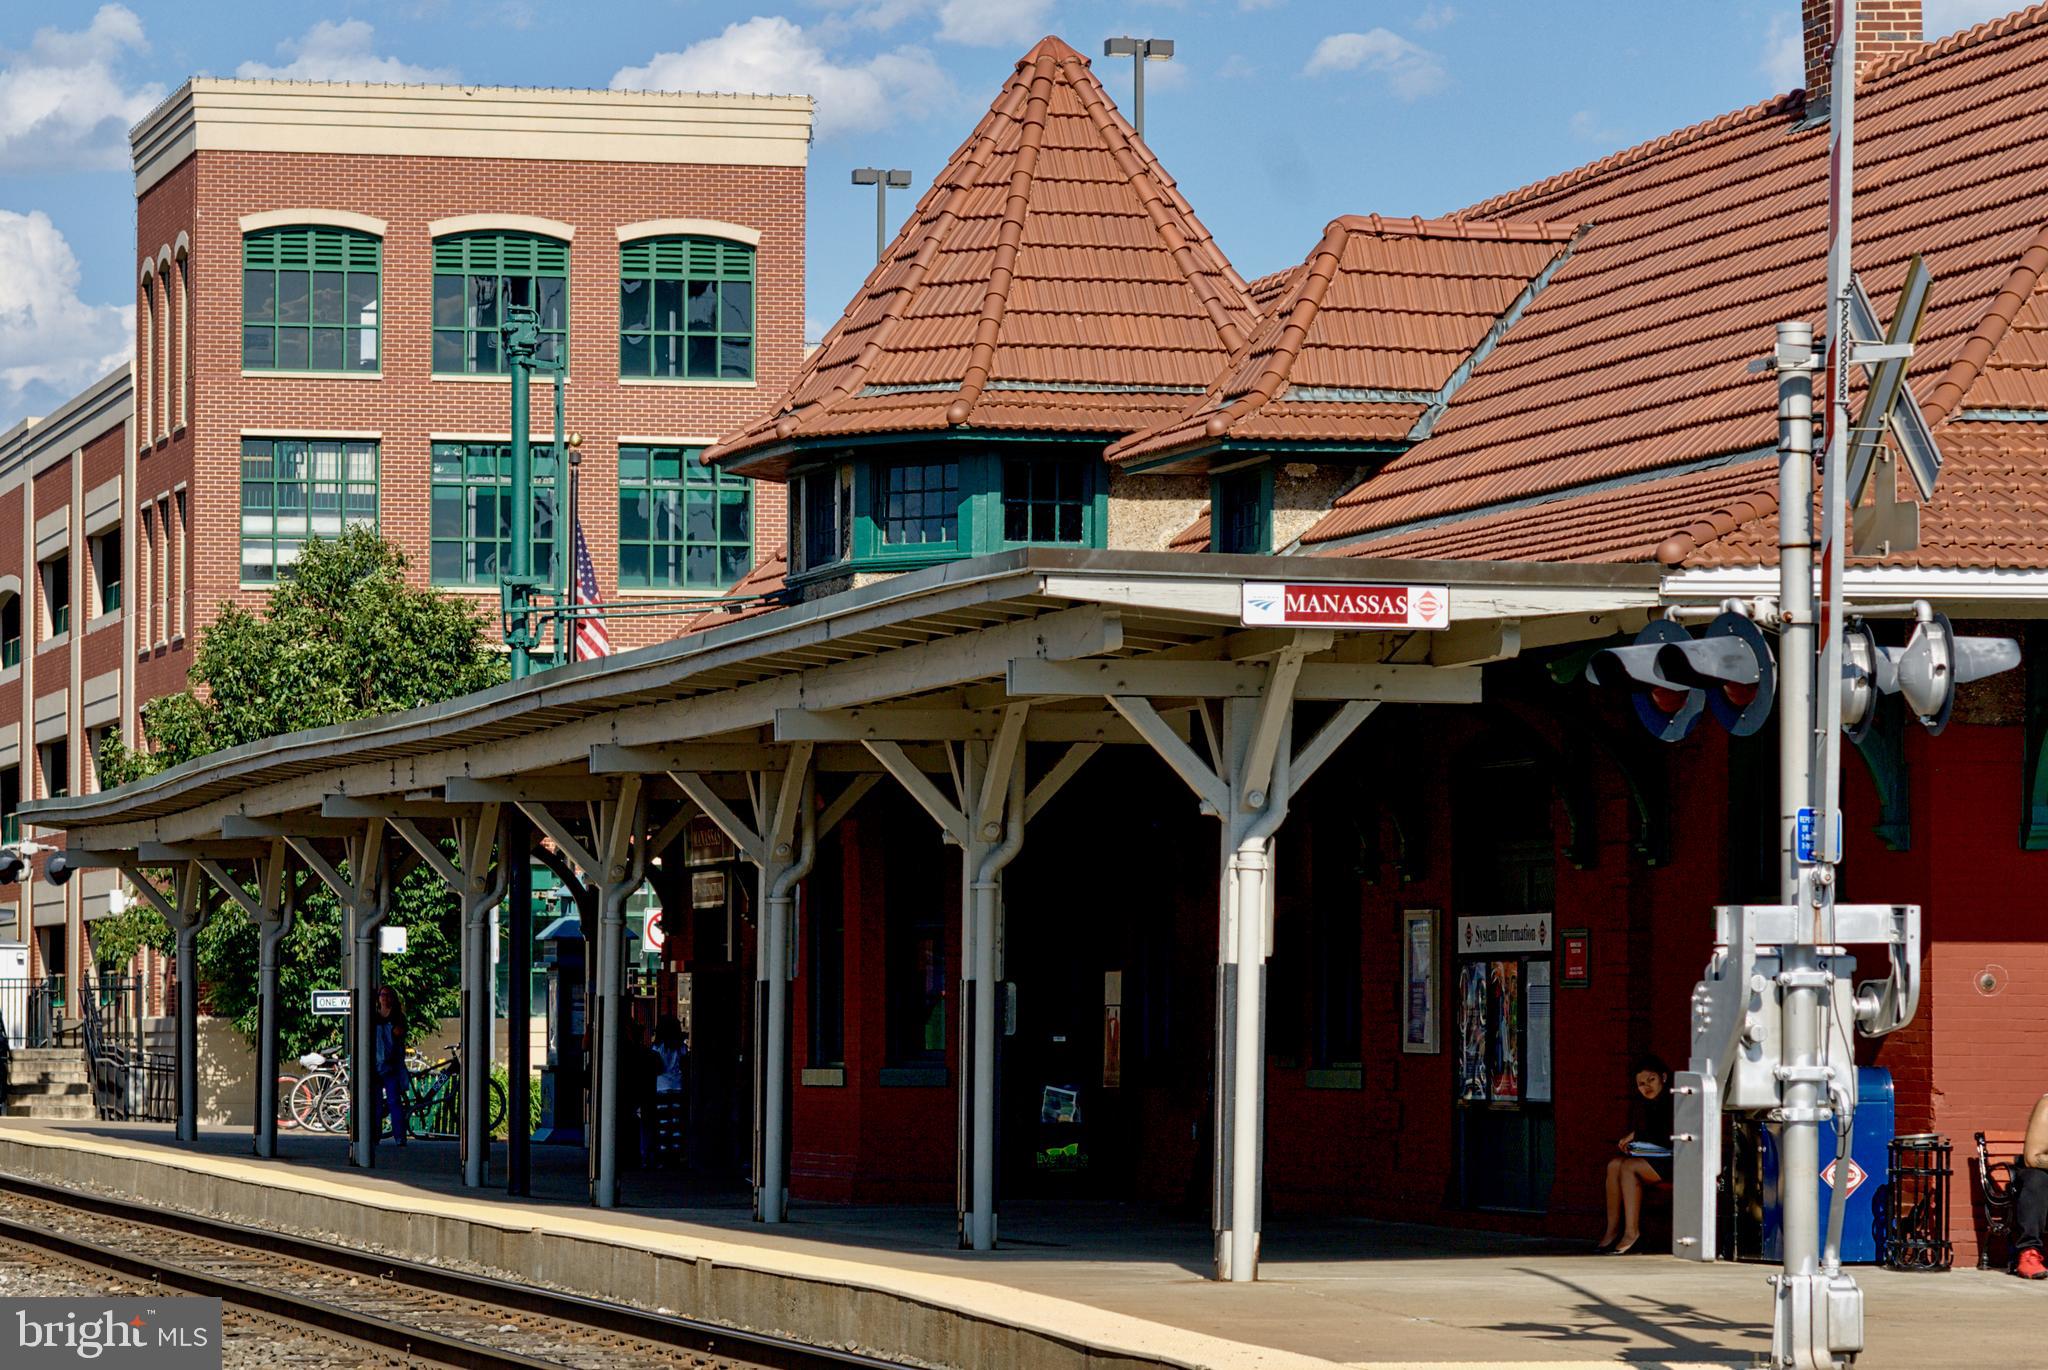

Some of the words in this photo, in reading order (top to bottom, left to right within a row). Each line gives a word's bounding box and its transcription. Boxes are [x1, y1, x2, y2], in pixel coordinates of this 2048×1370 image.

[1285, 593, 1408, 616] MANASSAS
[1475, 924, 1498, 947] System
[1498, 922, 1536, 943] Information
[319, 998, 337, 1007] ONE
